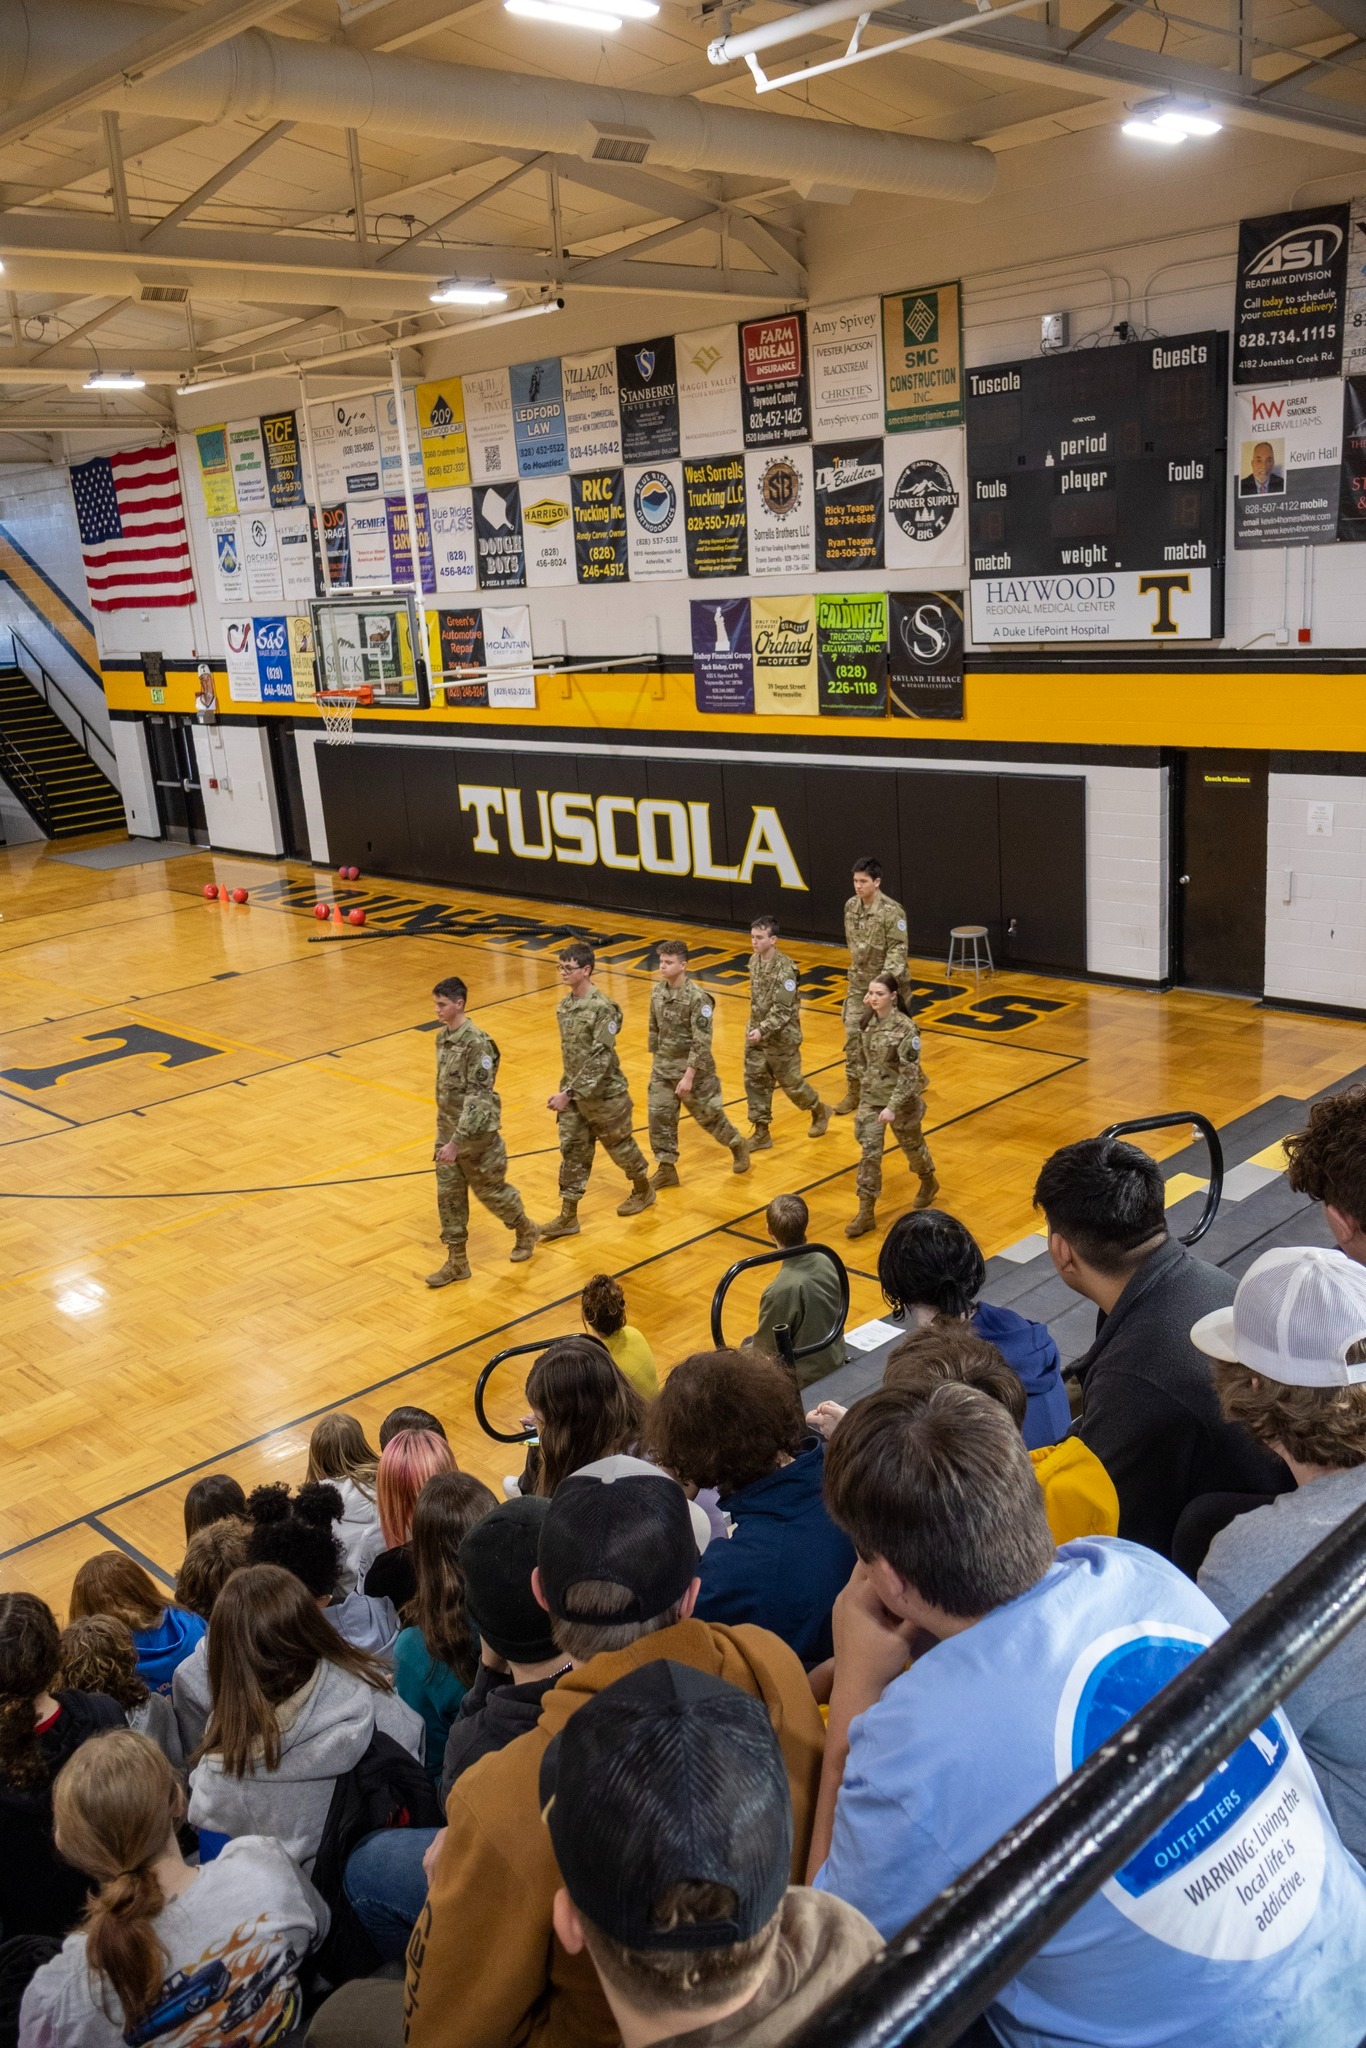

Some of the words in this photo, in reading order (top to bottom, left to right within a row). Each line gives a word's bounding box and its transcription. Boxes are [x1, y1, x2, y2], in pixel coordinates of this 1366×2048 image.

[1249, 239, 1324, 275] ASI
[1246, 276, 1271, 289] READY
[1272, 275, 1287, 286] MIX
[1289, 270, 1332, 283] DIVISION
[1244, 298, 1261, 309] Call
[1262, 294, 1284, 310] today
[1285, 294, 1295, 304] to
[1297, 288, 1336, 303] schedule
[1241, 312, 1261, 324] your
[1262, 306, 1298, 318] concrete
[1300, 298, 1337, 314] delivery!
[812, 320, 838, 336] Amy
[840, 313, 876, 332] Spivey
[760, 326, 793, 344] FARM
[1239, 324, 1336, 348] 828.734.1115
[748, 341, 795, 362] BUREAU
[843, 340, 873, 356] JACKSON
[1152, 344, 1208, 370] Guests
[905, 348, 938, 368] SMC
[1238, 360, 1258, 369] 4182
[1258, 356, 1294, 368] Jonathan
[1296, 354, 1319, 364] Creek
[1321, 352, 1335, 362] Rd.
[564, 362, 614, 384] VILLAZON
[756, 362, 796, 376] INSURANCE
[823, 360, 869, 376] BLACKSTREAM
[680, 382, 708, 392] MAGGIE
[711, 375, 738, 386] VALLEY
[890, 367, 956, 392] CONSTRUCTION
[970, 372, 1021, 396] Tuscola
[600, 383, 616, 396] Inc.
[620, 383, 675, 404] STANBERRY
[821, 384, 873, 400] CHRISTIE'S
[913, 391, 932, 404] INC.
[622, 398, 675, 412] INSURANCE
[753, 394, 777, 408] Haywood
[778, 391, 797, 405] County
[1252, 396, 1286, 421] kw
[1286, 396, 1308, 406] GREAT
[432, 408, 451, 426] 209
[516, 404, 560, 423] LEDFORD
[750, 408, 802, 429] 828-452-1425
[817, 410, 879, 428] AmySpivey.com
[1286, 406, 1317, 417] SMOKIES
[264, 420, 292, 444] RCF
[338, 428, 353, 438] WNC
[527, 422, 550, 436] LAW
[570, 441, 620, 459] 828-454-0642
[1060, 432, 1107, 460] period
[1290, 450, 1316, 464] Kevin
[1318, 447, 1338, 460] Hall
[523, 462, 532, 470] Go
[684, 466, 706, 484] West
[706, 461, 744, 483] Sorrells
[1168, 460, 1204, 482] fouls
[636, 474, 650, 494] BLUE
[652, 473, 672, 492] RIDGE
[834, 468, 876, 488] Builders
[1062, 470, 1108, 494] player
[582, 478, 612, 502] RKC
[688, 488, 726, 510] Trucking
[727, 486, 744, 504] LLC
[976, 480, 1007, 500] fouls
[825, 505, 845, 515] Ricky
[847, 504, 875, 514] Teague
[889, 498, 926, 510] PIONEER
[927, 495, 959, 507] SUPPLY
[1245, 501, 1299, 514] 828-507-4122
[1300, 498, 1328, 510] mobile
[432, 508, 448, 520] Blue
[450, 506, 472, 520] Ridge
[524, 508, 568, 520] HARRISON
[574, 504, 609, 524] Trucking
[610, 504, 625, 519] Inc.
[636, 508, 675, 532] ORTHODONTICS
[1242, 518, 1260, 526] email
[351, 517, 386, 530] PREMIER
[434, 516, 473, 534] GLASS
[688, 514, 746, 531] 828-550-7474
[902, 520, 916, 536] GO
[917, 530, 934, 540] BIG
[754, 529, 774, 541] Sorrells
[1238, 528, 1263, 538] website
[479, 535, 522, 556] DOUGH
[828, 538, 846, 548] Ryan
[847, 537, 874, 548] Teague
[1164, 540, 1206, 562] match
[246, 552, 278, 564] ORCHARD
[446, 551, 466, 563] (828)
[541, 548, 559, 557] (828)
[589, 546, 615, 562] (828)
[826, 548, 876, 558] 828-506-3376
[1062, 544, 1108, 568] weight
[440, 566, 474, 576] 456-8420
[486, 556, 519, 574] BOYS
[582, 564, 624, 578] 246-4512
[974, 552, 1011, 572] match
[986, 576, 1116, 604] HAYWOOD
[986, 603, 1032, 616] REGIONAL
[1034, 602, 1075, 614] MEDICAL
[1077, 601, 1116, 612] CENTER
[1138, 573, 1192, 635] T
[446, 616, 475, 626] Green's
[820, 602, 883, 630] CALDWELL
[256, 626, 284, 650] S&S
[442, 630, 482, 640] Automotive
[830, 632, 862, 641] TRUCKING
[914, 604, 942, 658] S
[993, 626, 1002, 637] A
[1002, 626, 1026, 637] Duke
[1028, 624, 1070, 636] LifePoint
[1071, 624, 1110, 638] Hospital
[450, 643, 474, 655] Repair
[486, 641, 530, 650] MOUNTAIN
[754, 630, 814, 655] Orchard
[865, 645, 882, 653] INC.
[734, 652, 752, 660] Group
[768, 658, 798, 666] COFFEE
[836, 666, 867, 680] (828)
[927, 676, 961, 684] TERRACE
[828, 682, 878, 694] 226-1118
[458, 784, 810, 891] TUSCOLA
[1154, 1788, 1242, 1869] OUTFITTERS
[1184, 1837, 1259, 1907] WARNING:
[1252, 1801, 1290, 1844] Living
[1283, 1786, 1300, 1812] the
[1236, 1868, 1269, 1906] local
[1264, 1850, 1287, 1881] life
[1282, 1842, 1296, 1864] is
[1256, 1876, 1307, 1932] addictive.
